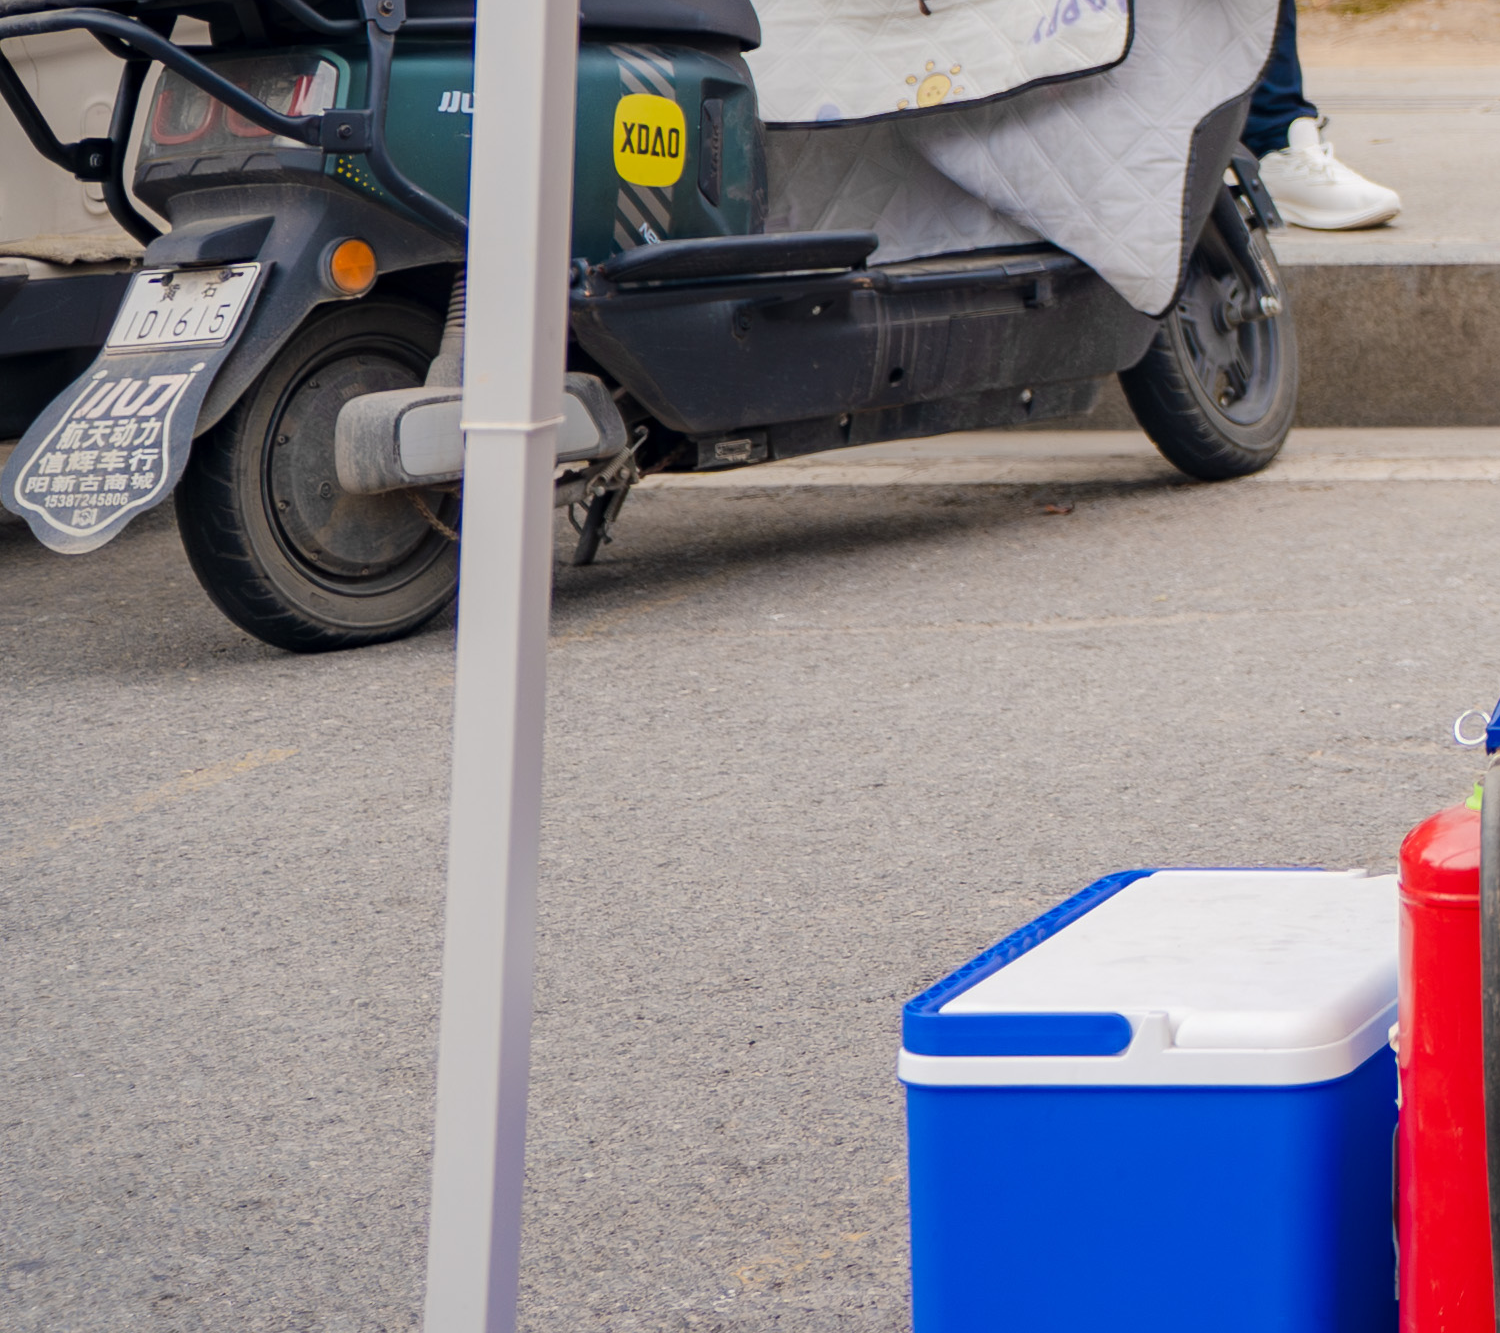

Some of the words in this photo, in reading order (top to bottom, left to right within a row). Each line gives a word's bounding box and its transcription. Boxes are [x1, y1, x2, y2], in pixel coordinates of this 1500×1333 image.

[620, 121, 680, 159] XDAO
[55, 417, 163, 450] 航天动力
[38, 447, 160, 475] 信辉车行
[25, 472, 155, 494] 阳新古商城
[44, 492, 129, 509] 15387245806
